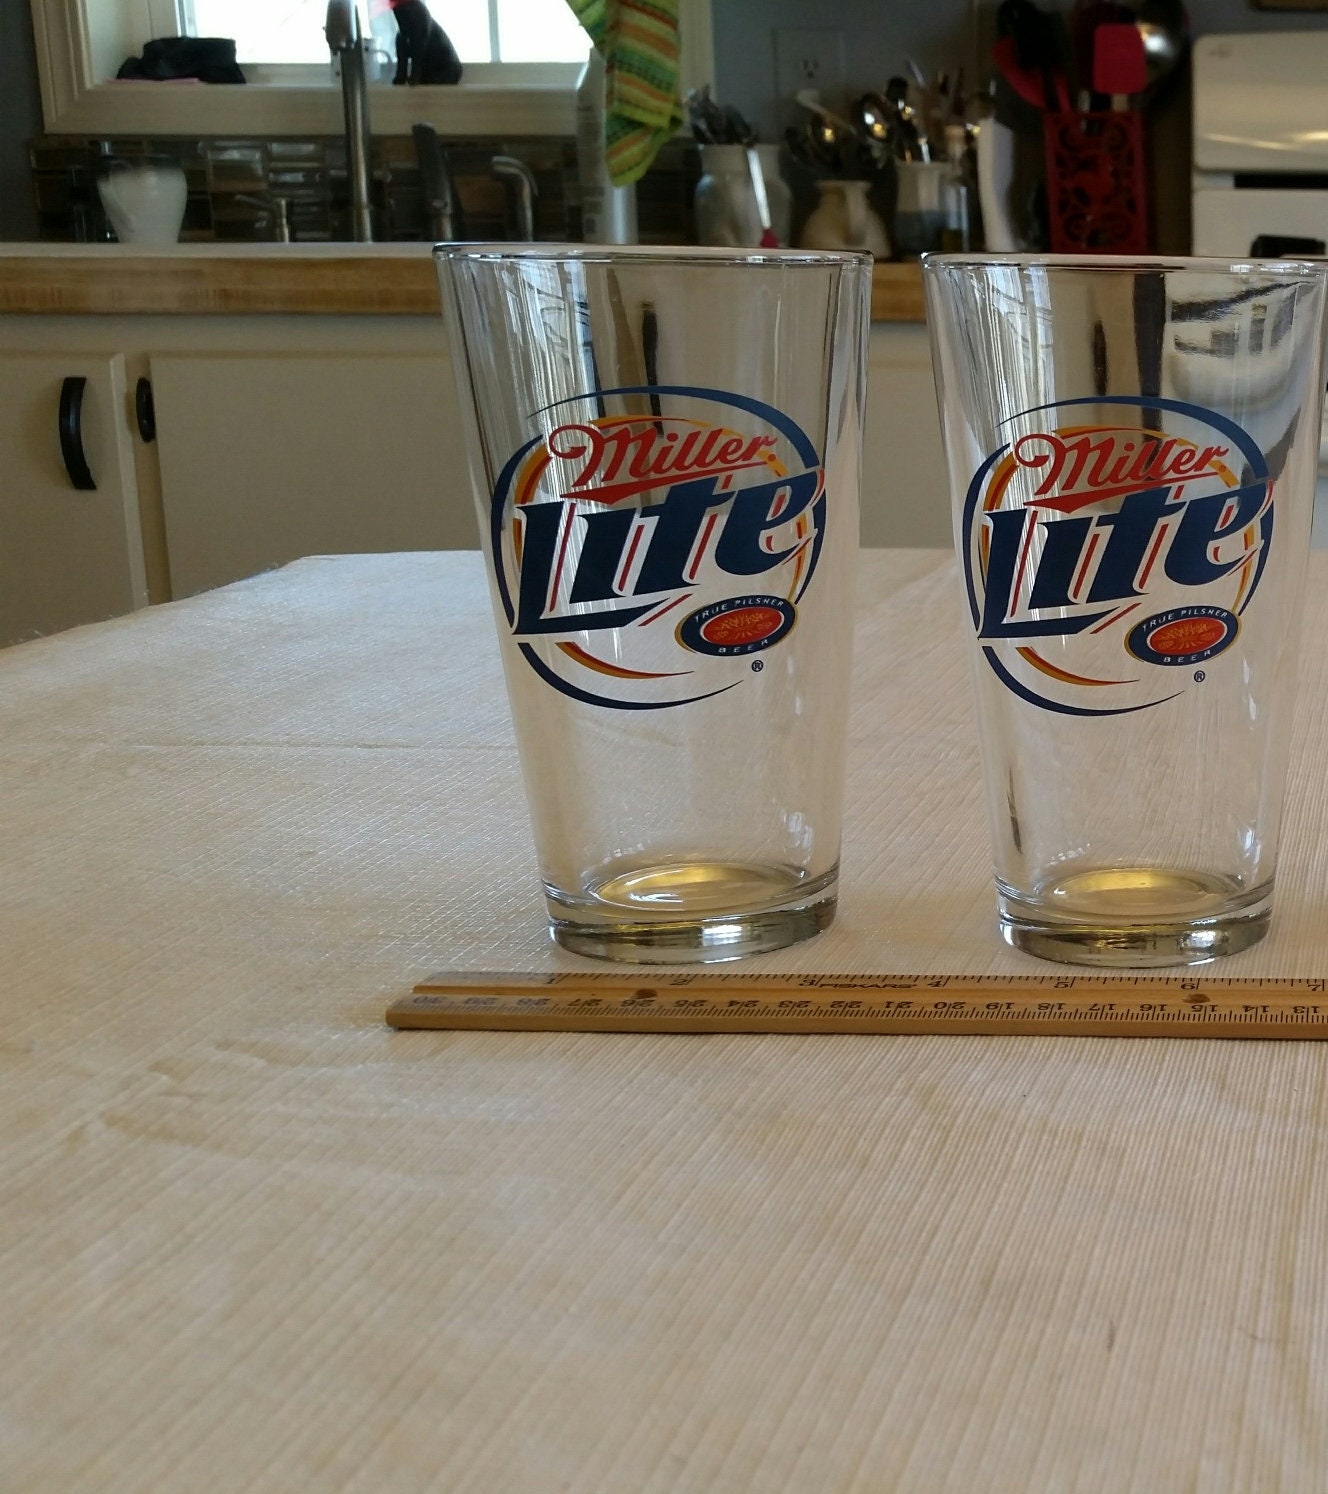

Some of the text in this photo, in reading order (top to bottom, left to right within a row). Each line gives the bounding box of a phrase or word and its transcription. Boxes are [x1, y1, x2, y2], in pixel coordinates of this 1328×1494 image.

[549, 424, 777, 487] Miller
[1015, 434, 1229, 495] Miller
[513, 472, 819, 635] Lite
[977, 484, 1268, 640] Lite
[694, 597, 784, 621] TRUE PILSNER
[1142, 608, 1229, 631] TRUE PILSNER
[718, 638, 770, 654] BEER
[1163, 649, 1212, 663] BEER
[927, 980, 942, 988] 4
[1308, 984, 1321, 992] 7
[568, 998, 602, 1007] 27
[621, 999, 657, 1008] 26
[673, 999, 708, 1008] 25
[727, 1000, 760, 1008] 24
[778, 1000, 812, 1008] 23
[830, 1000, 862, 1009] 22
[884, 1001, 914, 1010] 21
[934, 1002, 966, 1010] 20
[986, 1002, 1014, 1010] 19
[1038, 1002, 1066, 1010] 18
[1140, 1004, 1168, 1012] 16
[1191, 1004, 1218, 1012] 15
[1242, 1004, 1270, 1013] 14
[1293, 1006, 1320, 1014] 13
